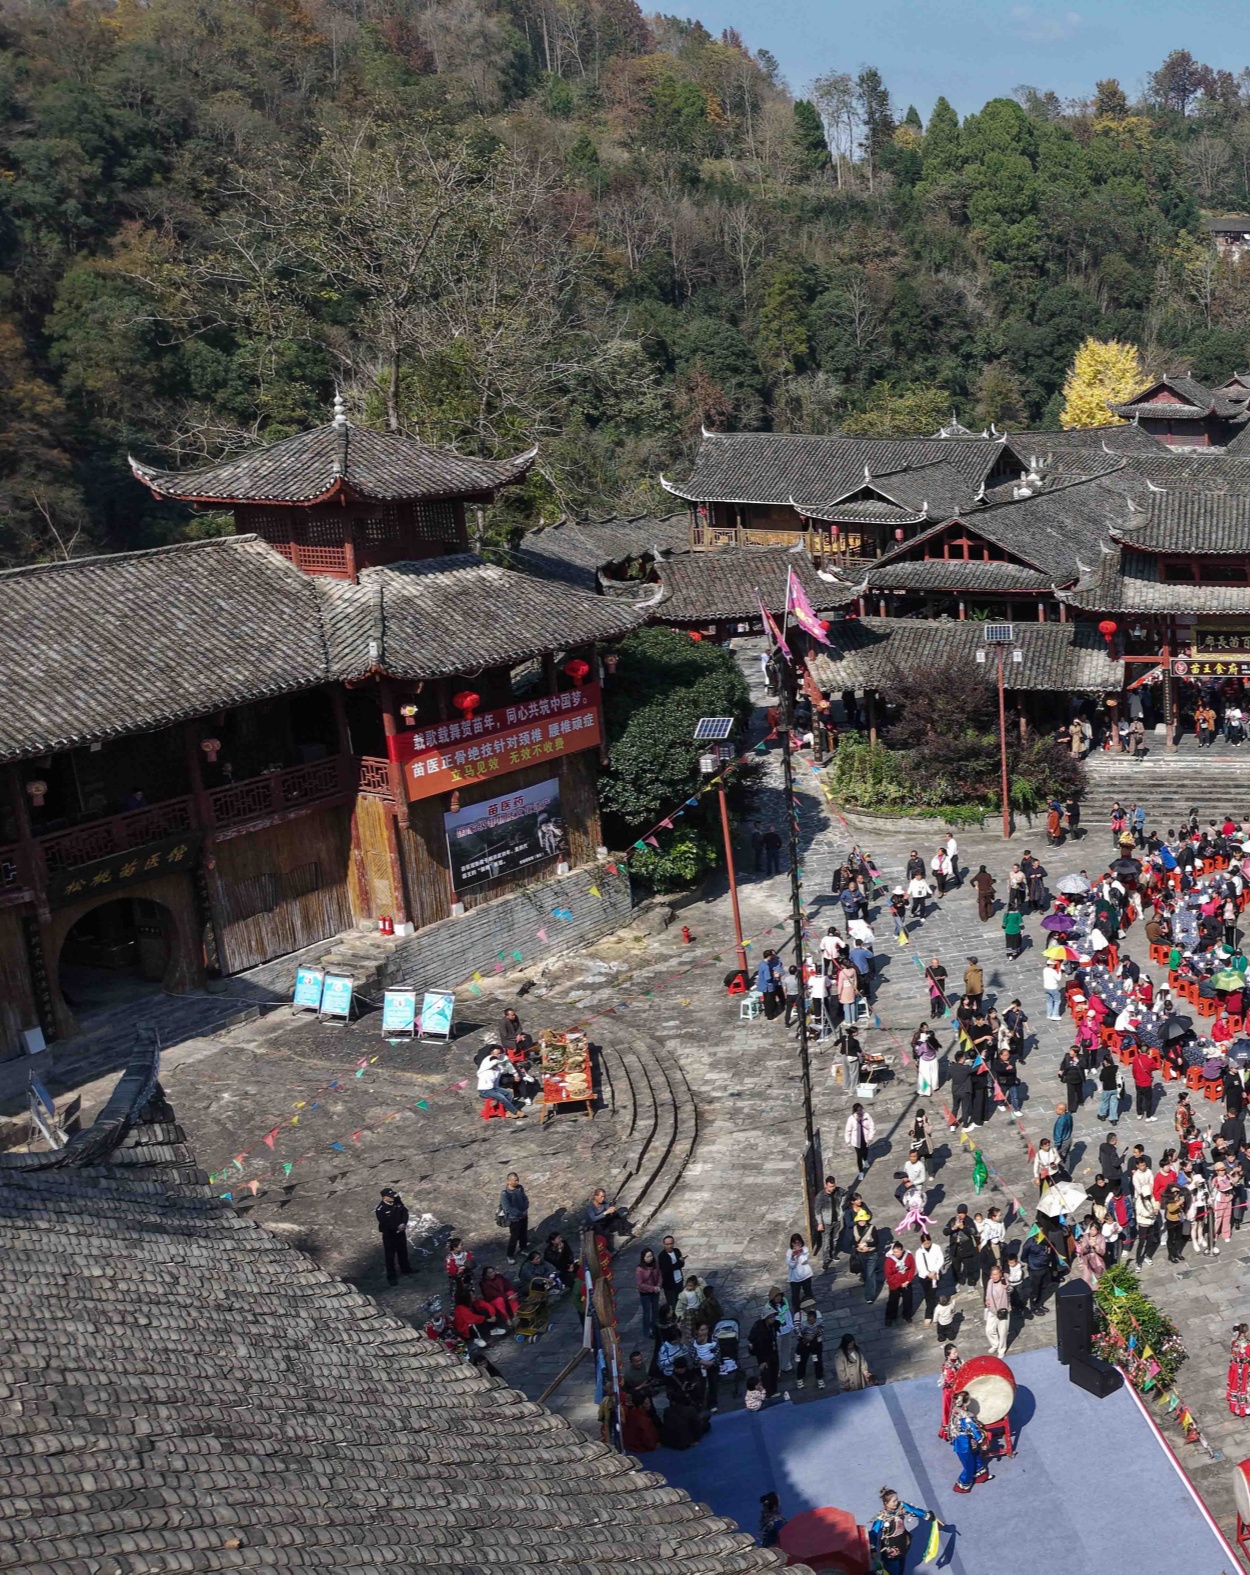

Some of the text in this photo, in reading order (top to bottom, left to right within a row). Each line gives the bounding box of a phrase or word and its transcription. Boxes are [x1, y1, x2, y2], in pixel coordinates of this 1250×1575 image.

[1190, 662, 1239, 675] 苗王食府
[412, 713, 595, 779] 苗医正骨绝技针对颈椎 腰椎顽症
[451, 737, 565, 782] 立马见效 无效不收费
[488, 795, 525, 816] 苗医药
